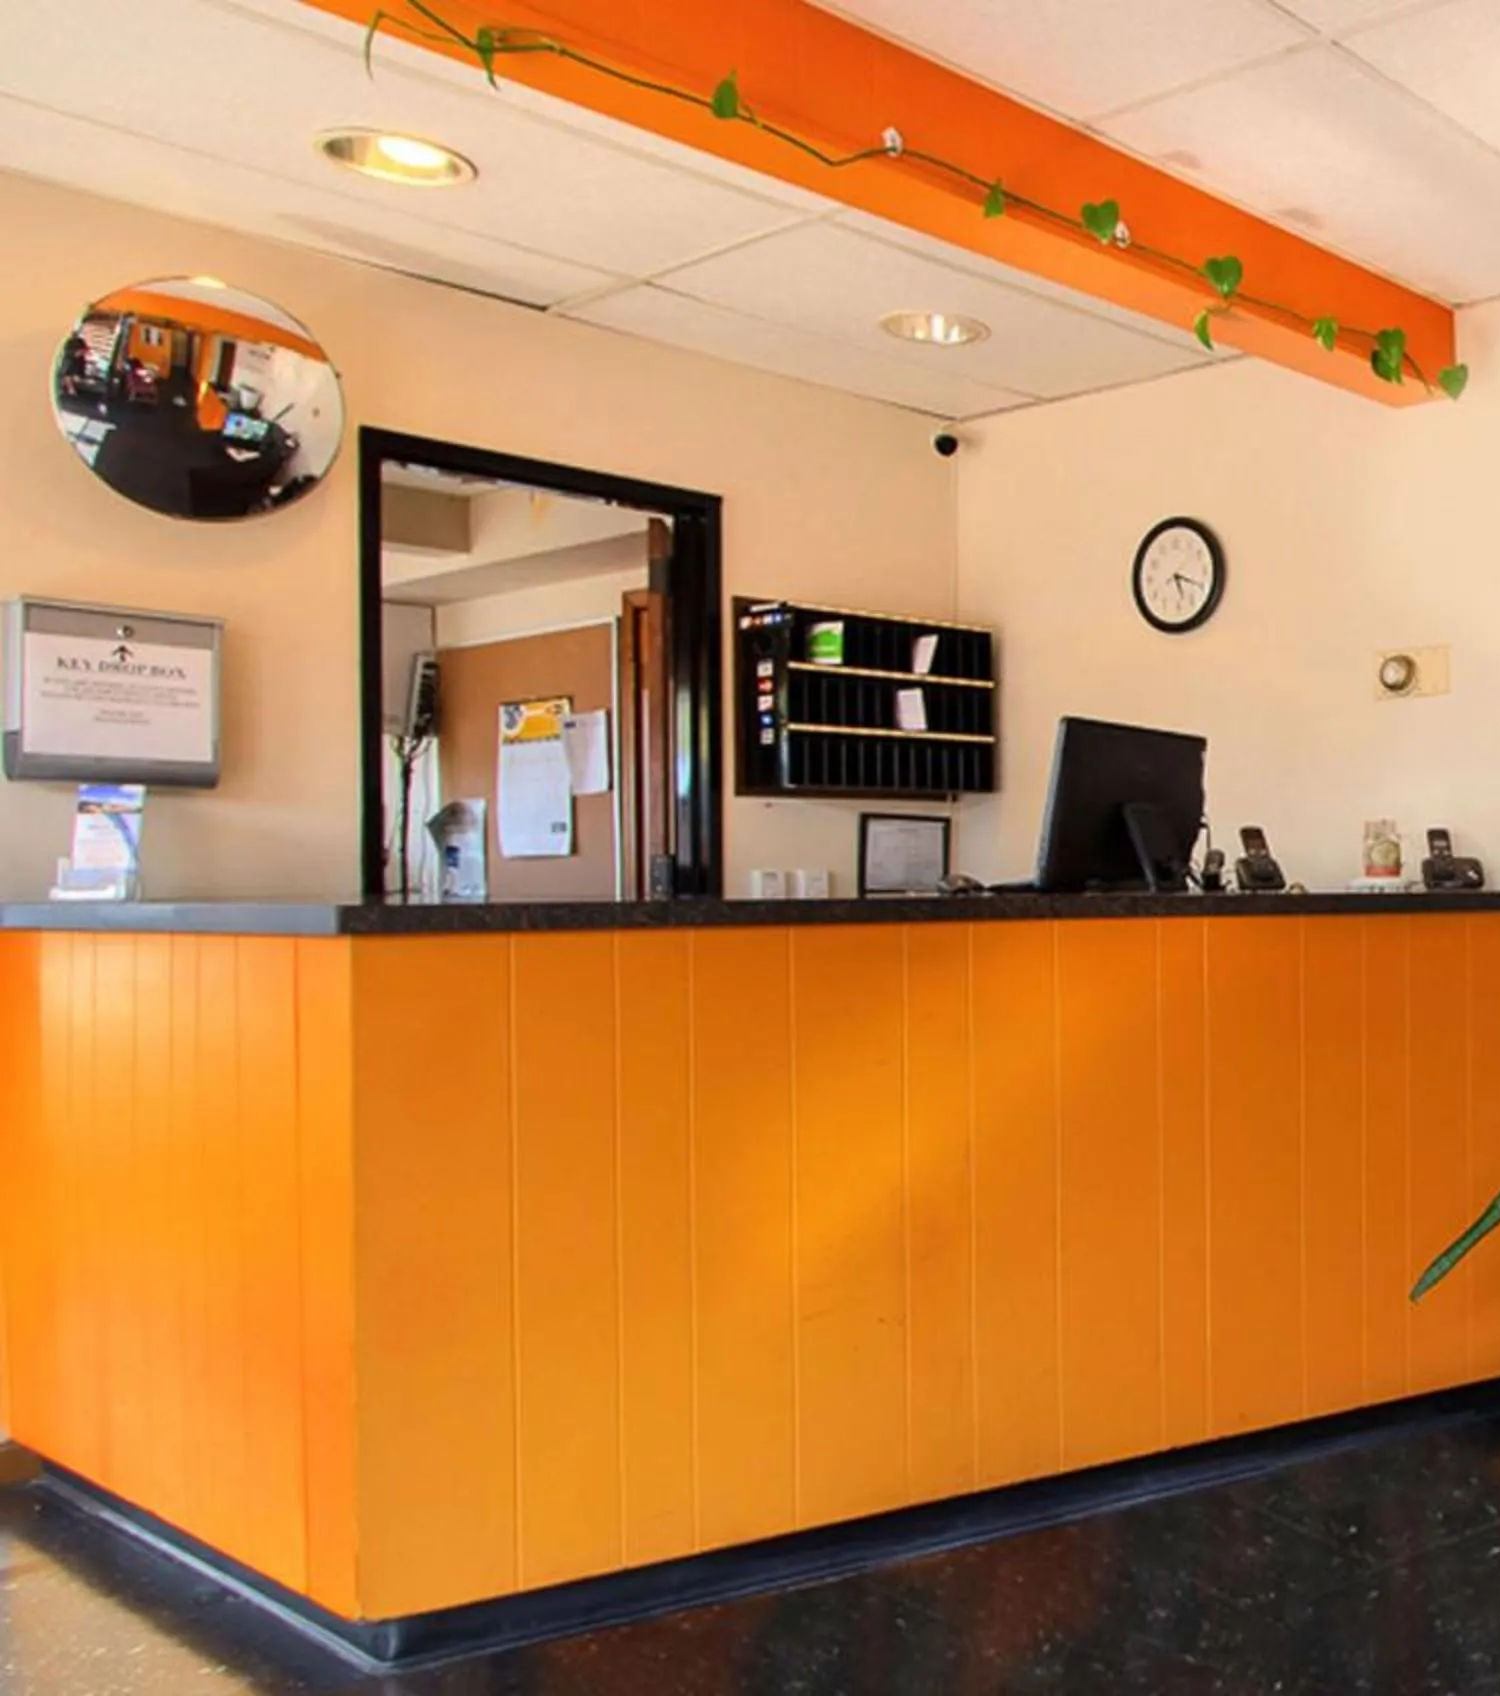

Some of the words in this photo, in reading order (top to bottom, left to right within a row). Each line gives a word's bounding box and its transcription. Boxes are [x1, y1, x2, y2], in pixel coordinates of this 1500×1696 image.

[57, 656, 92, 671] KEY
[98, 660, 147, 676] DROP
[150, 666, 187, 680] BOX
